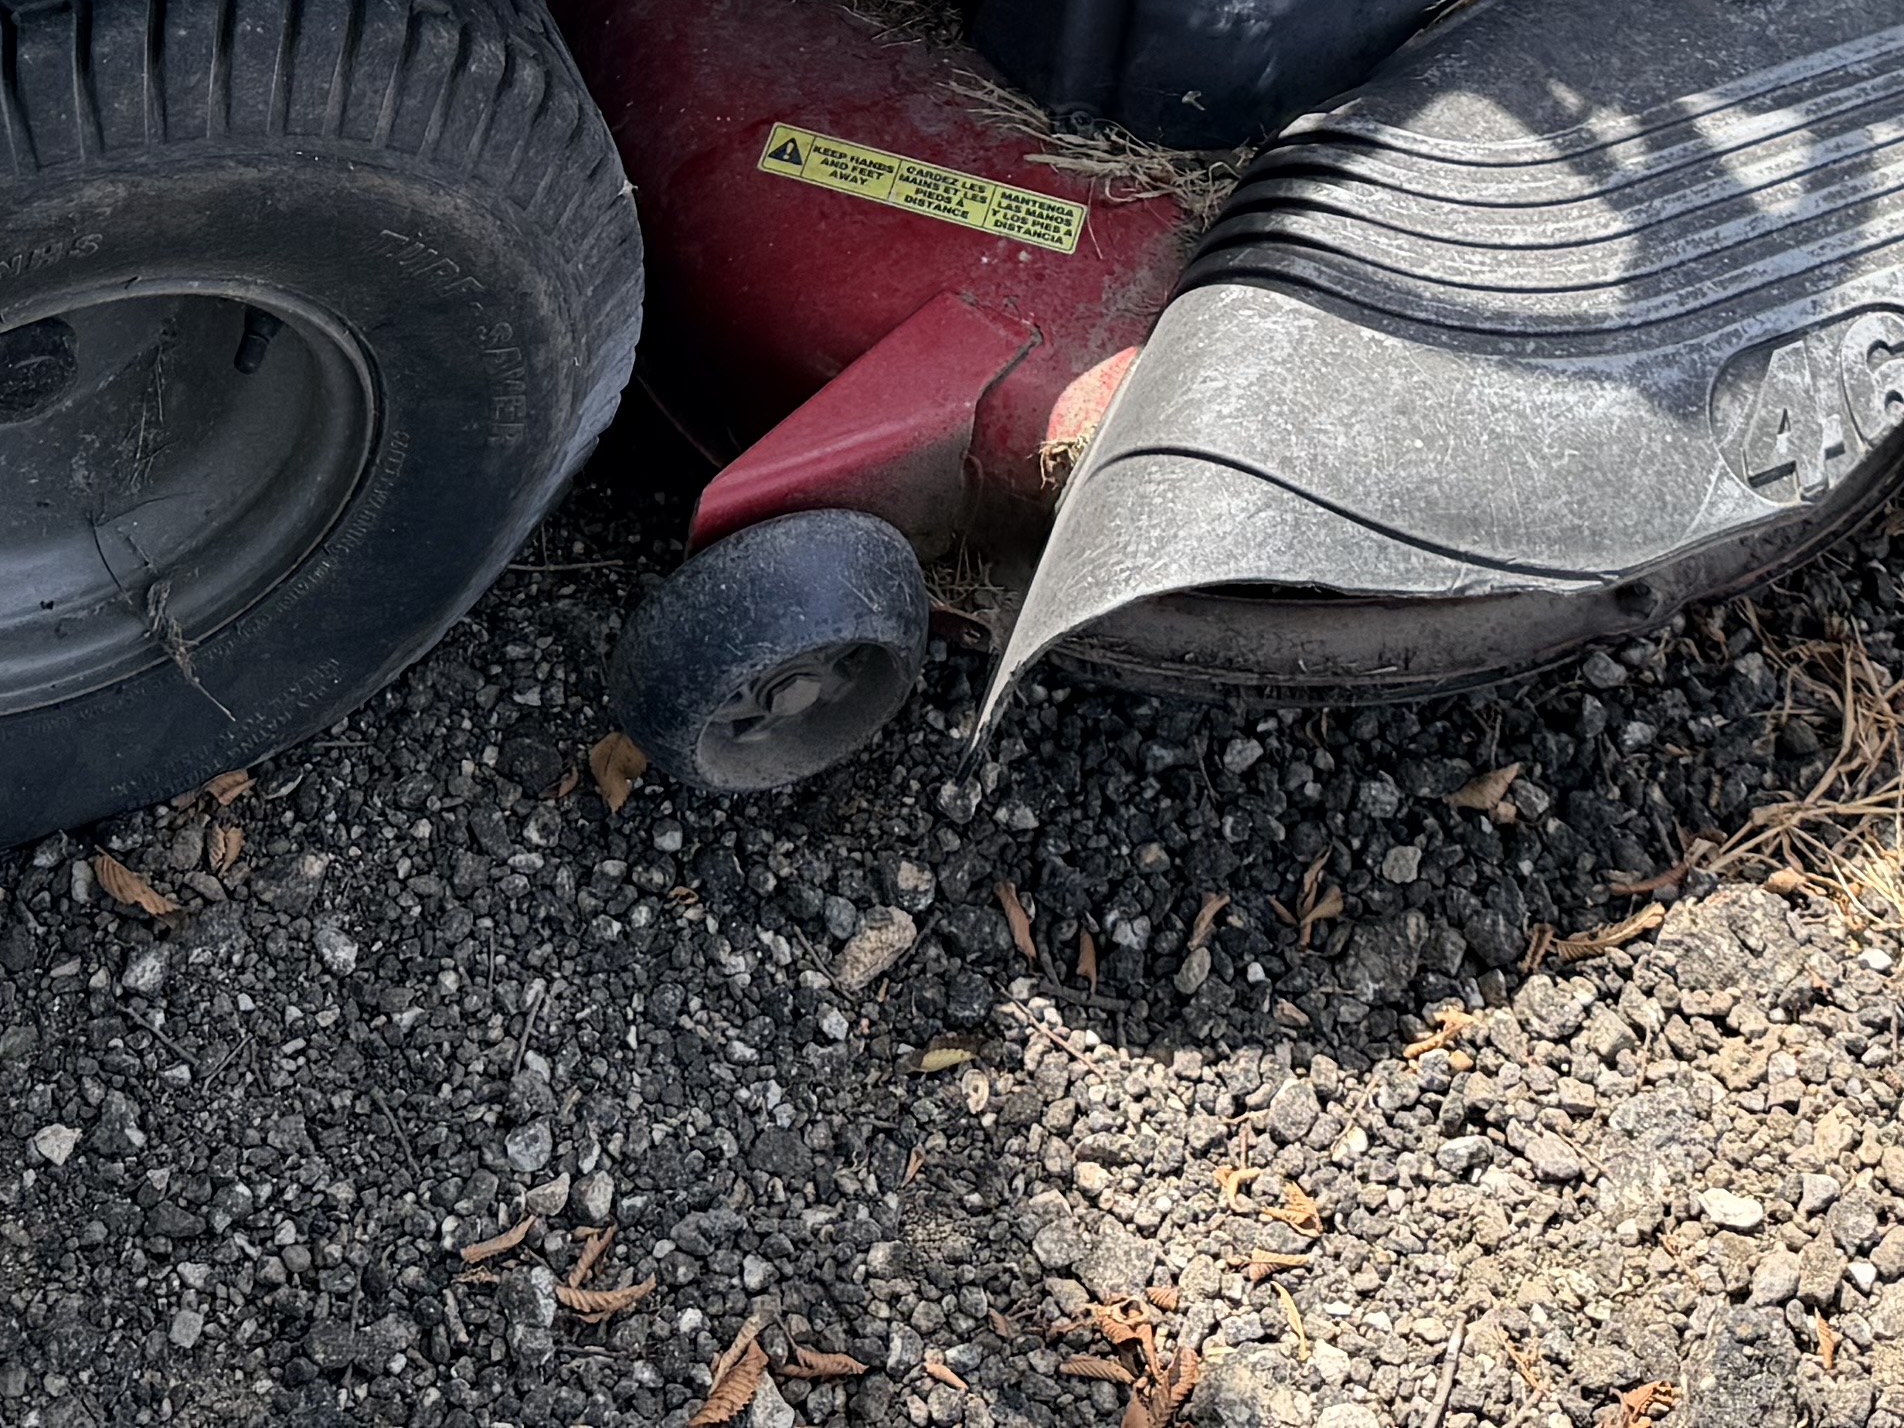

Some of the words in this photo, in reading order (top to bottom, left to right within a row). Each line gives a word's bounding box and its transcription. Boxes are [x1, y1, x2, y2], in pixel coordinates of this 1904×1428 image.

[812, 145, 848, 160] KEEP
[849, 155, 895, 174] HANDS
[820, 157, 848, 171] AND
[851, 165, 885, 181] FEET
[828, 170, 869, 186] AWAY
[898, 173, 940, 191] MAINS
[943, 185, 961, 196] ET
[963, 191, 988, 204] LES
[961, 181, 986, 194] LES
[904, 194, 970, 220] DISTANCE
[914, 187, 953, 204] PIEDS
[1000, 191, 1074, 217] MANTENGA
[991, 207, 1000, 217] Y
[1002, 211, 1029, 225] LOS
[1063, 228, 1073, 237] A
[997, 200, 1022, 214] LAS
[1025, 207, 1073, 227] MANOS
[993, 219, 1064, 245] DISTANCIA
